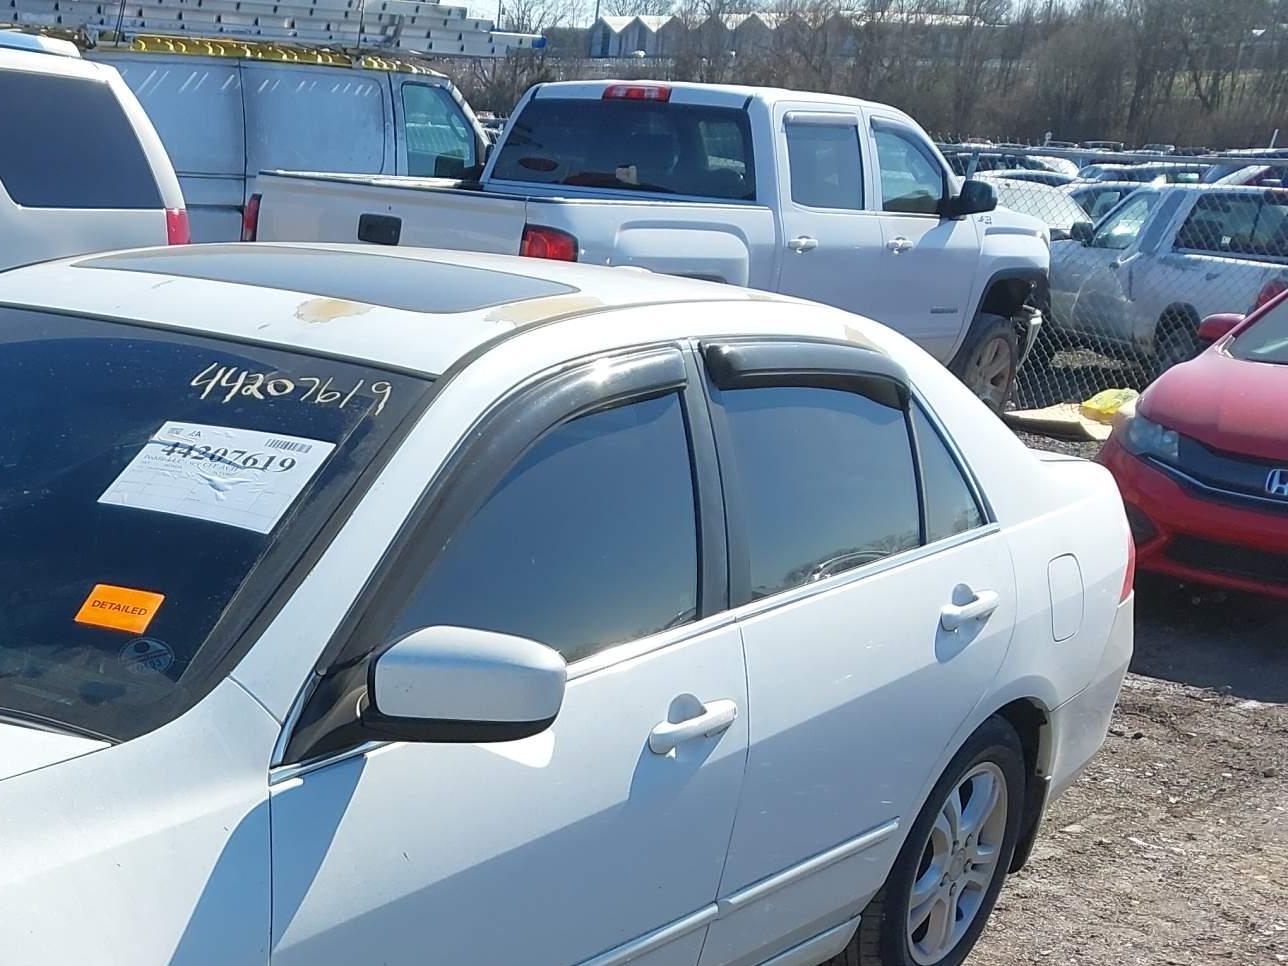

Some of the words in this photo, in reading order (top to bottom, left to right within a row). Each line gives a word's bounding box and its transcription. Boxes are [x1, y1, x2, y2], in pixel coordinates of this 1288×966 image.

[190, 361, 392, 416] 44207619
[161, 441, 297, 473] 44207619
[91, 599, 148, 616] DETAILED
